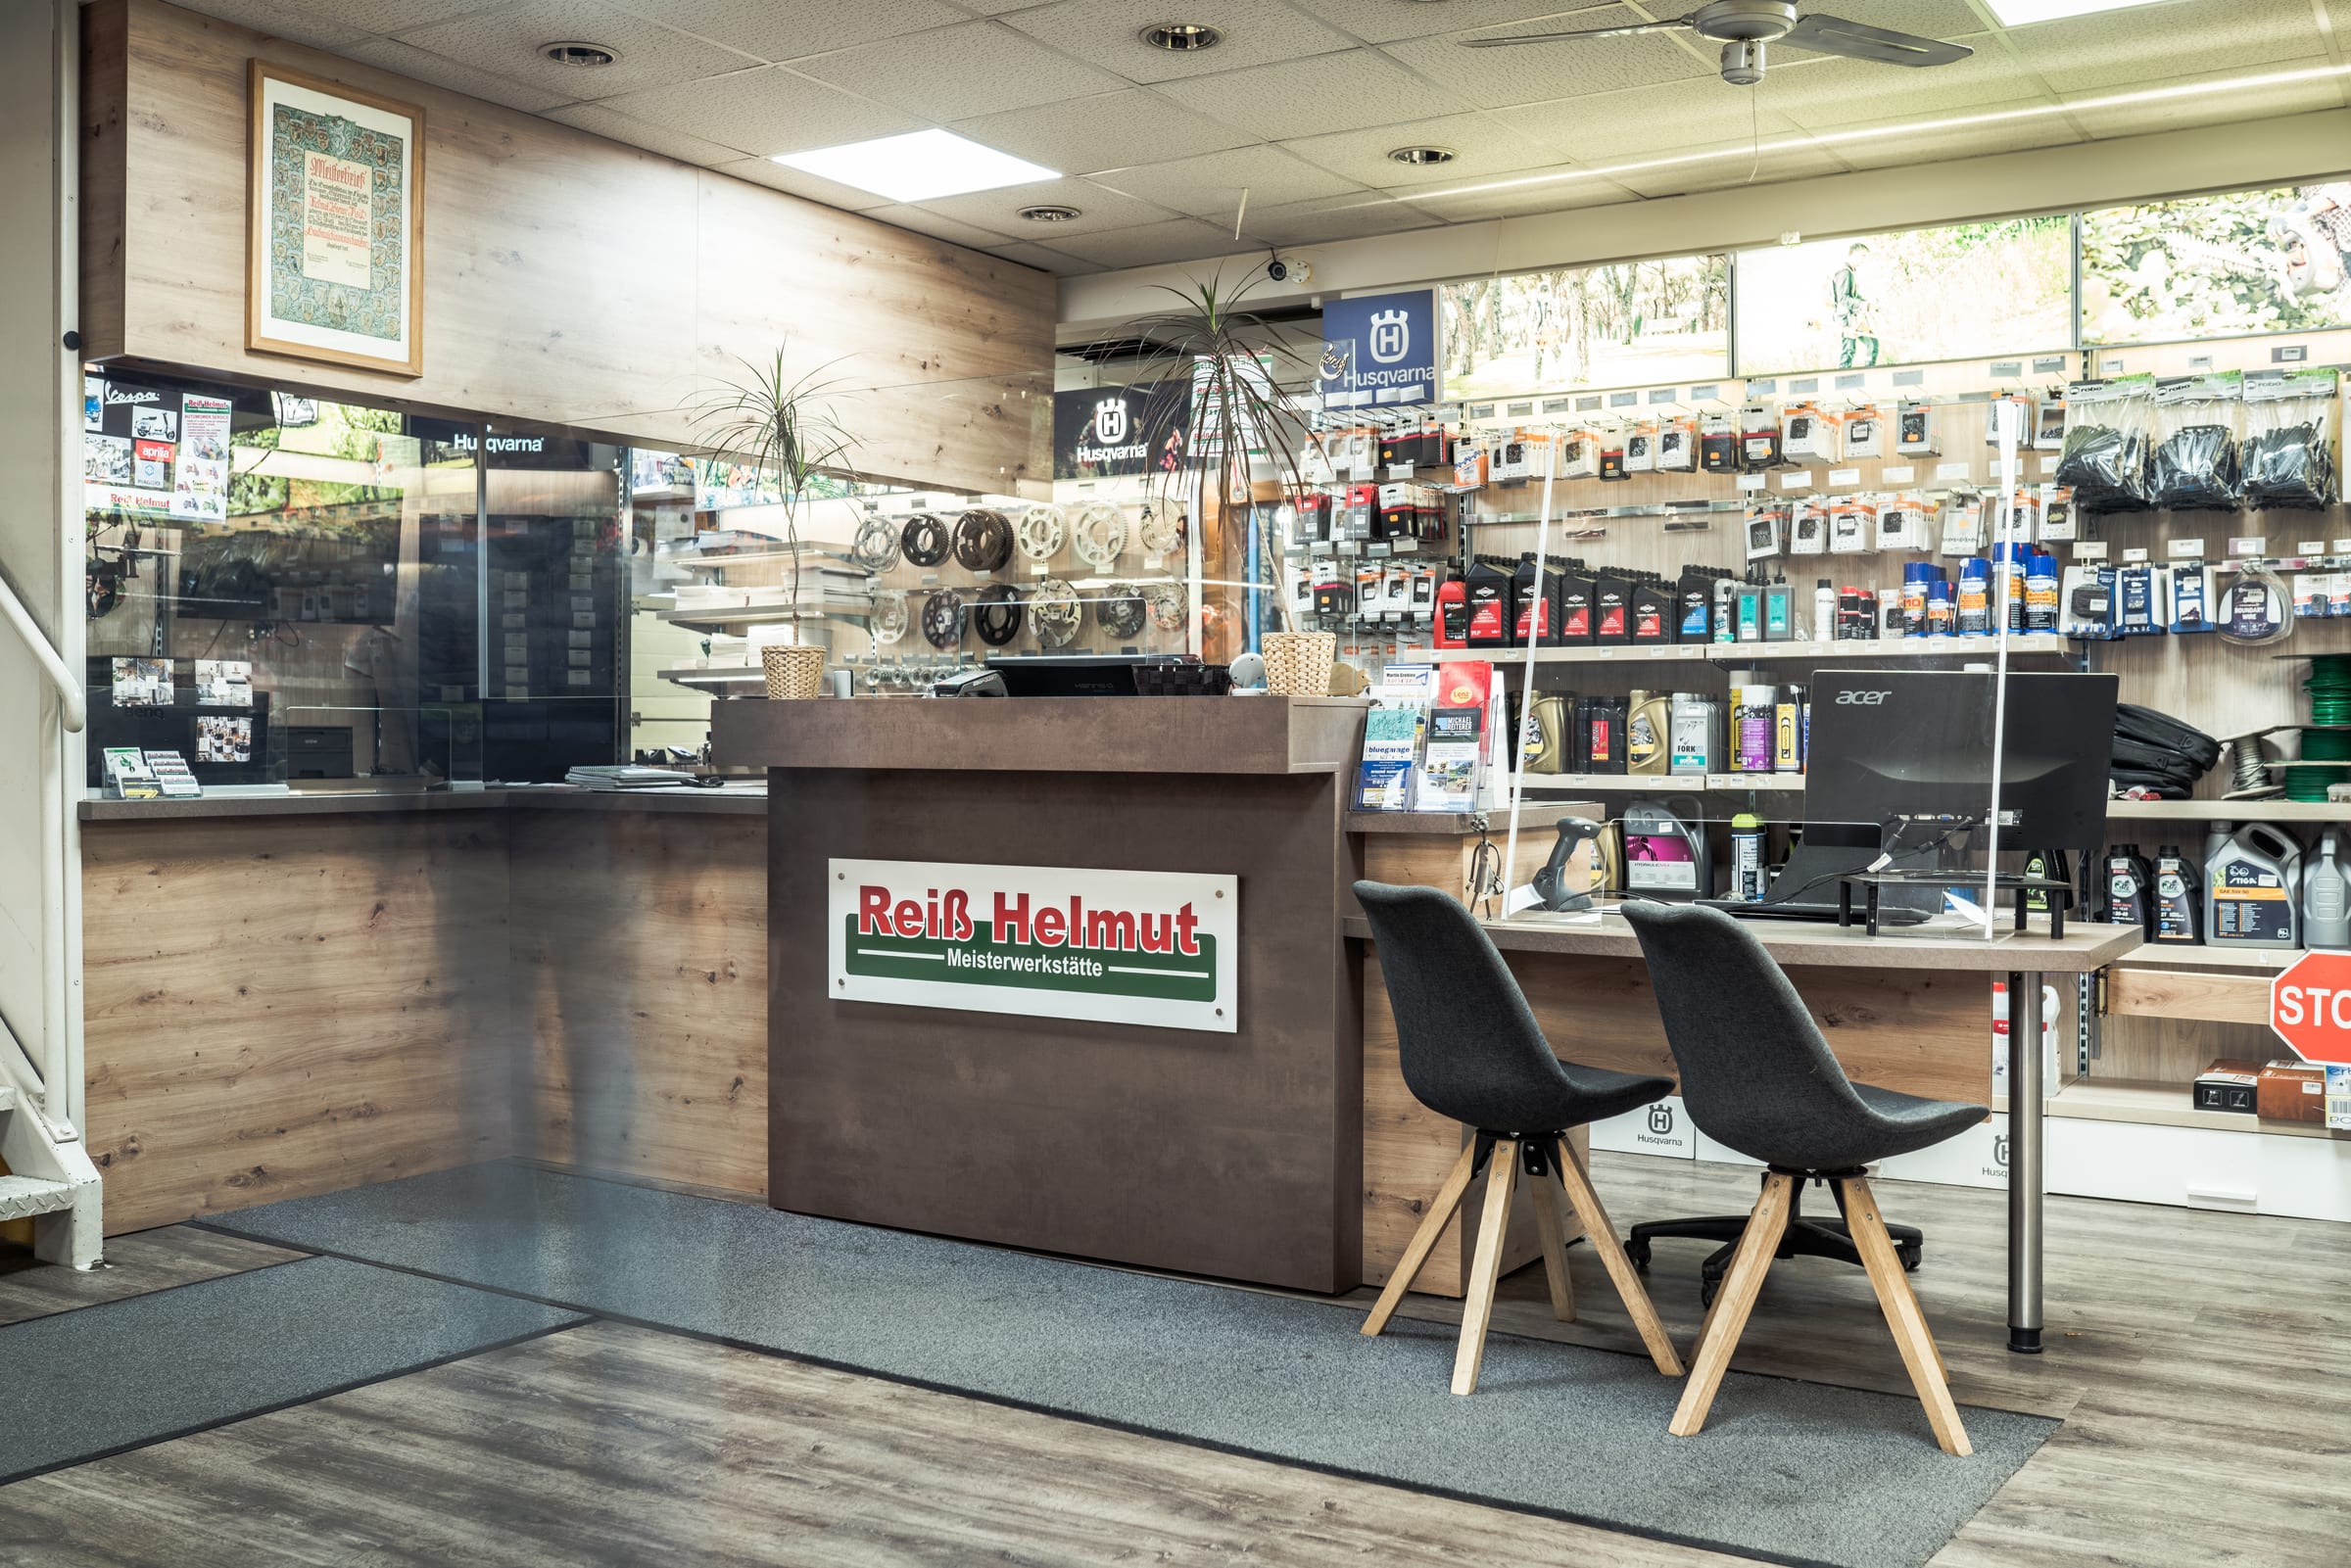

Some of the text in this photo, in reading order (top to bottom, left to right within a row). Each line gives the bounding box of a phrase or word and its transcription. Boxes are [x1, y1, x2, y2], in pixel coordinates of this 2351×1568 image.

[1343, 366, 1434, 388] Husqvarna
[105, 380, 160, 404] Vespa
[2168, 384, 2190, 393] robo
[142, 446, 169, 458] aprilia
[454, 434, 543, 453] Huqvarna
[1077, 445, 1147, 462] Husqvarna
[135, 495, 170, 508] Helmut
[1835, 690, 1892, 704] acer
[858, 884, 1201, 956] Reiß Helmut
[946, 947, 1103, 977] Meisterwerkstätte
[2279, 985, 2351, 1029] STO
[1637, 1133, 1683, 1146] Husqvarna
